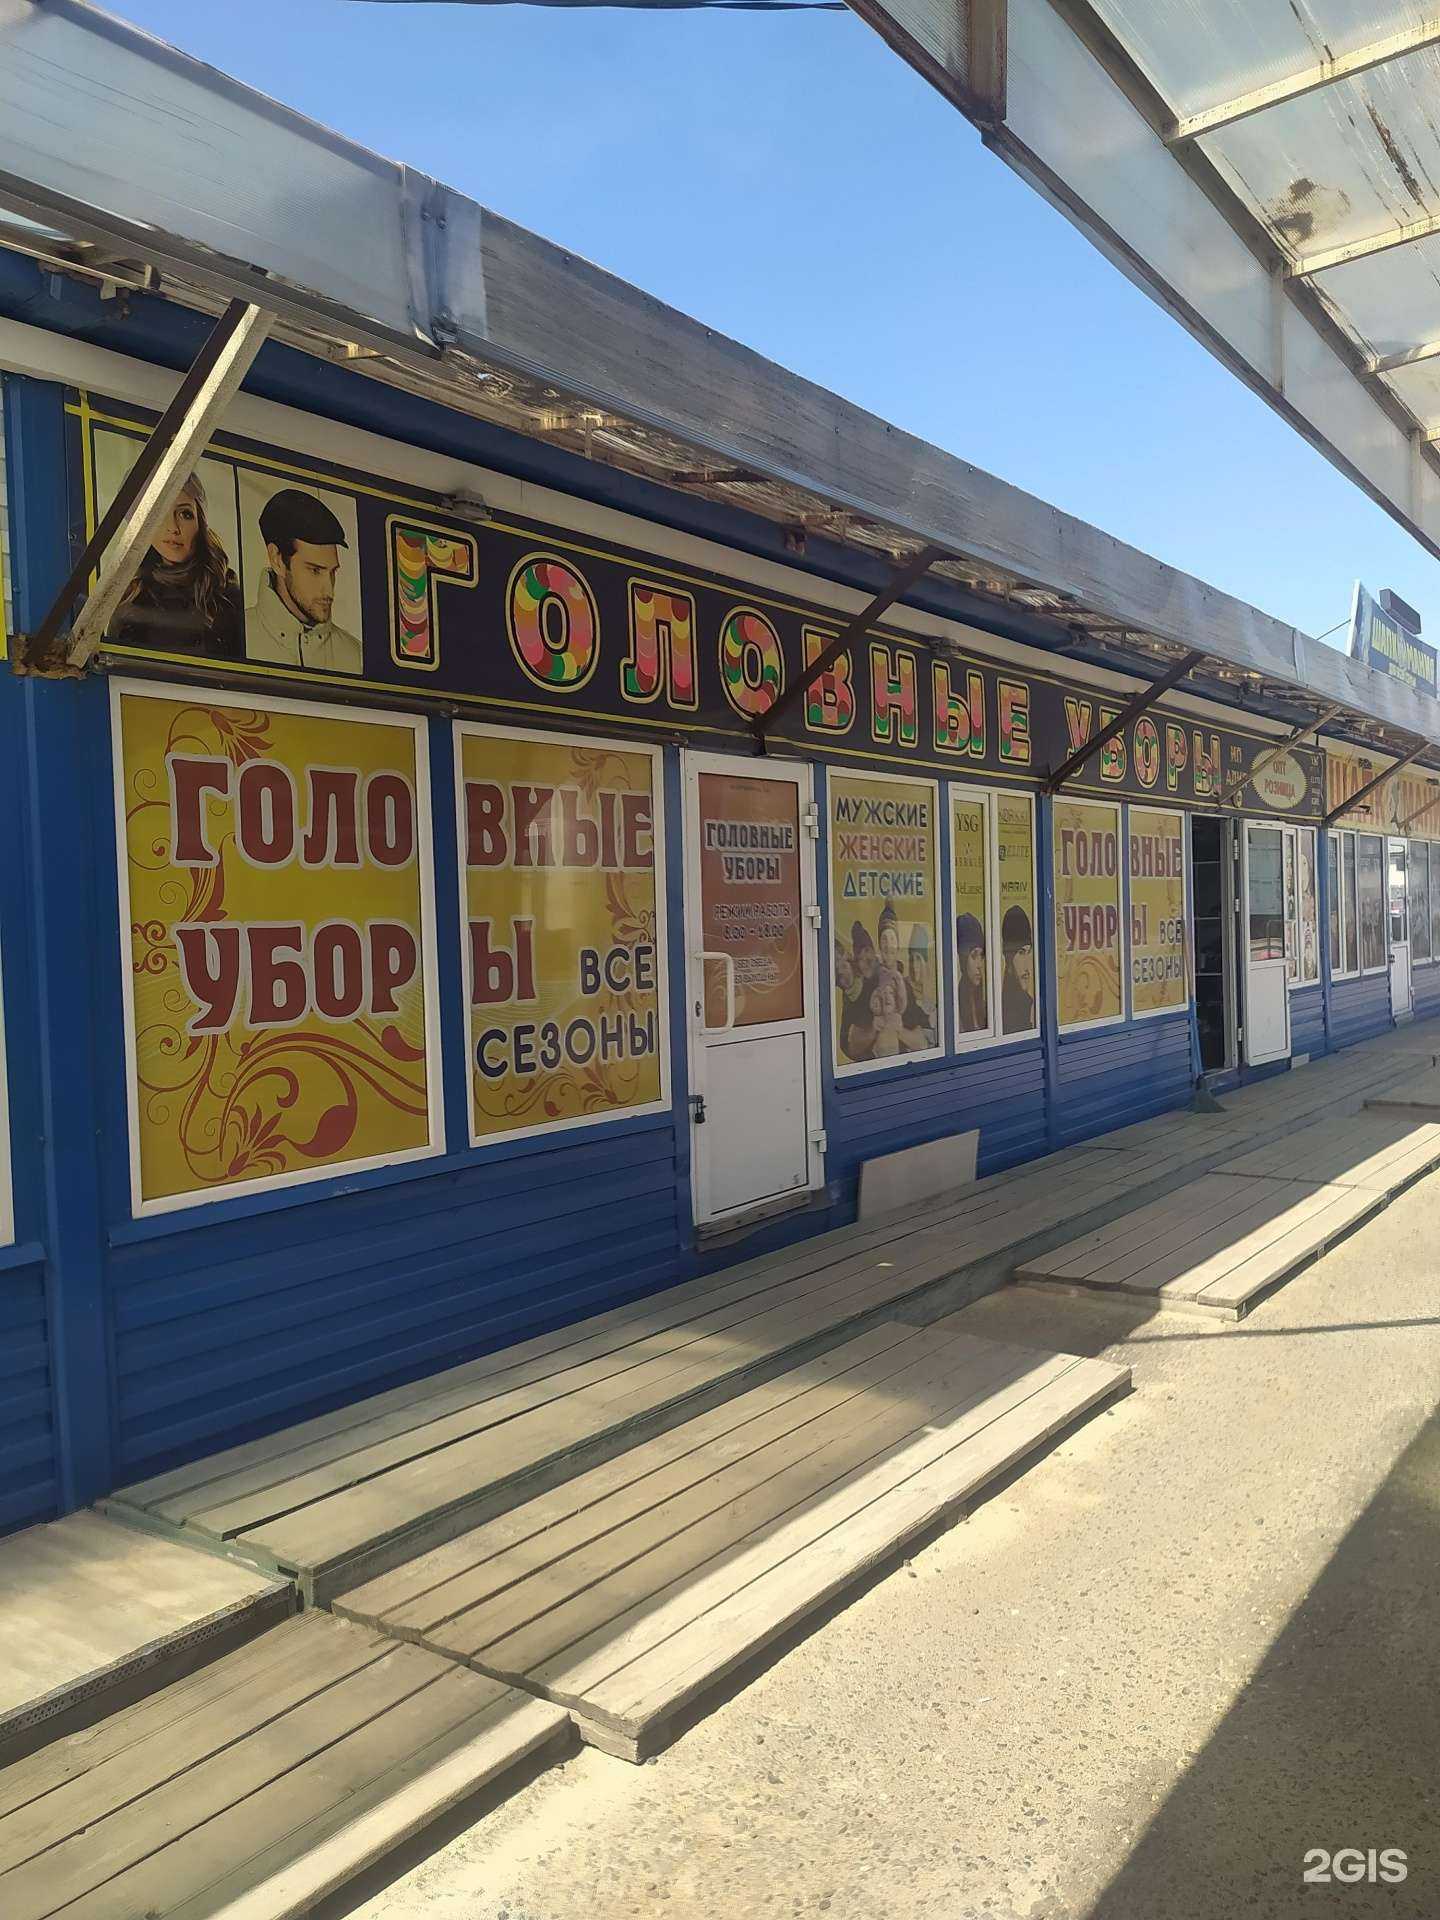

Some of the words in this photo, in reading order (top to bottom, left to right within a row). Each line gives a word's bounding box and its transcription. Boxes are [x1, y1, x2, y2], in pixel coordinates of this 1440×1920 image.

[386, 514, 1032, 767] ГОЛОВНЫЕ
[1063, 696, 1222, 798] УБОРЫ
[836, 797, 928, 828] МУЖСКИЕ
[955, 813, 979, 832] YSG
[705, 822, 793, 849] ГОЛОВНЫЕ
[839, 834, 927, 862] ЖЕНСКИЕ
[723, 856, 780, 881] УБОРЫ
[843, 871, 924, 897] ДЕТСКИЕ
[1159, 919, 1183, 945] ВСЕ
[580, 945, 654, 996] ВСЕ
[1132, 956, 1183, 984] СЕЗОНЫ
[476, 1010, 655, 1079] СЕЗОНЫ
